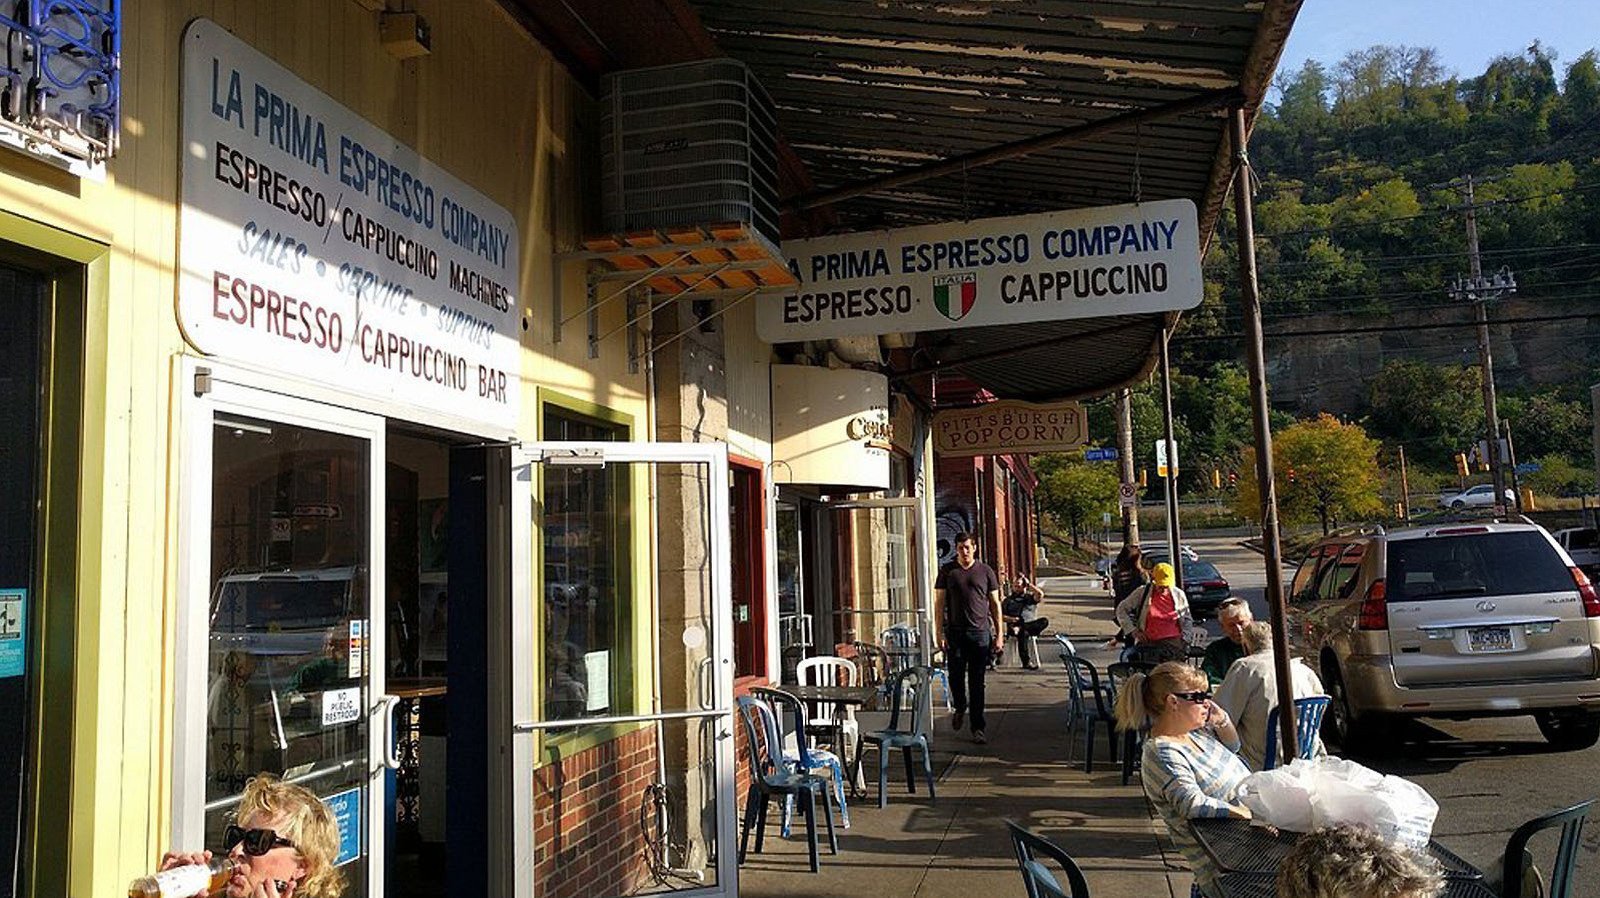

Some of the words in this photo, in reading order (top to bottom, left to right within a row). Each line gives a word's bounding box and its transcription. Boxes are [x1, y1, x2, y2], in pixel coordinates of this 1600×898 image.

[212, 57, 244, 130] LA
[254, 82, 329, 175] PRIMA
[340, 135, 434, 230] ESPRESSO
[441, 197, 509, 269] COMPANY
[787, 256, 803, 283] A
[812, 249, 891, 282] PRIMA
[902, 233, 1030, 274] ESPRESSO
[1043, 219, 1179, 260] COMPANY
[237, 220, 307, 275] SALES
[335, 262, 414, 316] SERVICE
[934, 273, 975, 285] ITALIA
[450, 259, 510, 313] MACHINES
[783, 285, 912, 324] ESPRESSO
[1001, 262, 1168, 304] CAPPUCCINO
[478, 364, 508, 404] BAR
[942, 413, 1074, 433] PITTSBURGH
[949, 425, 1067, 447] POPCORN
[331, 700, 353, 711] PUBLIC
[338, 691, 347, 700] NO
[325, 709, 358, 723] RESTROOM
